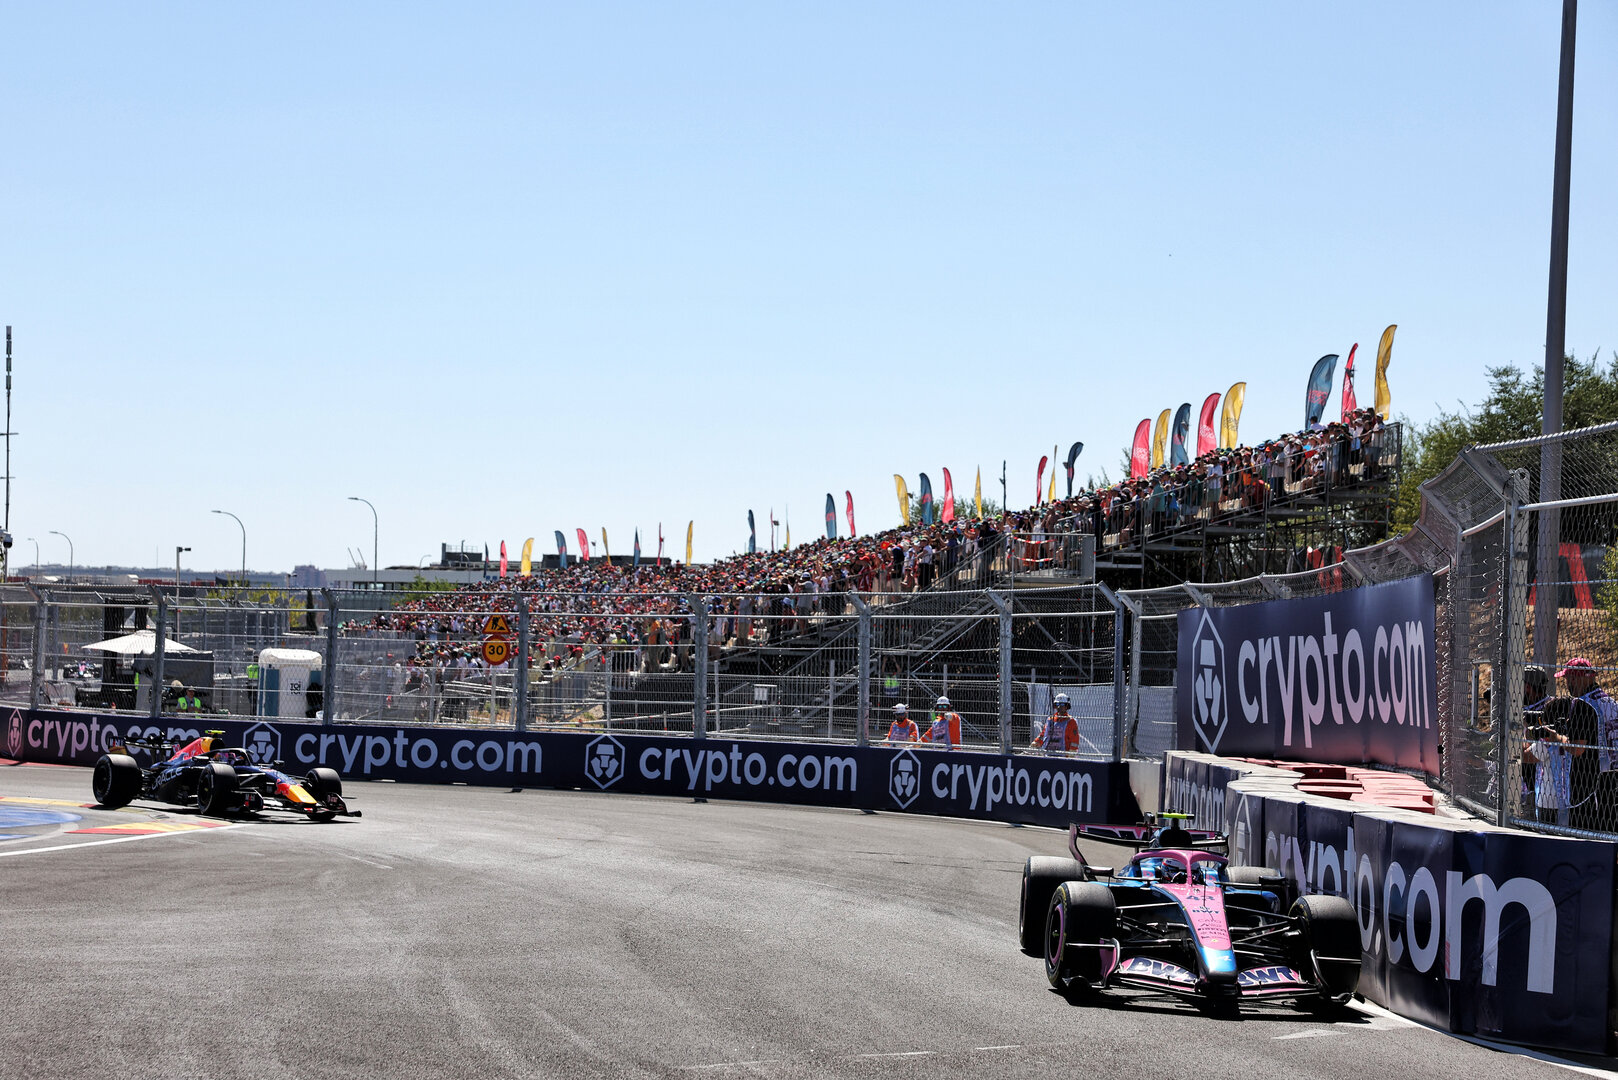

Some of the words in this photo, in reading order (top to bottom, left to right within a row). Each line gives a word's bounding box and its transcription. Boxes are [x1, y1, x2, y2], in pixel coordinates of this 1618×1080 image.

[488, 645, 504, 655] 30
[1238, 611, 1431, 748] crypto.com
[28, 716, 200, 757] cryptocom
[295, 730, 542, 774] crypto.com
[639, 744, 857, 792] crypto.com
[932, 759, 1093, 812] crypto.com
